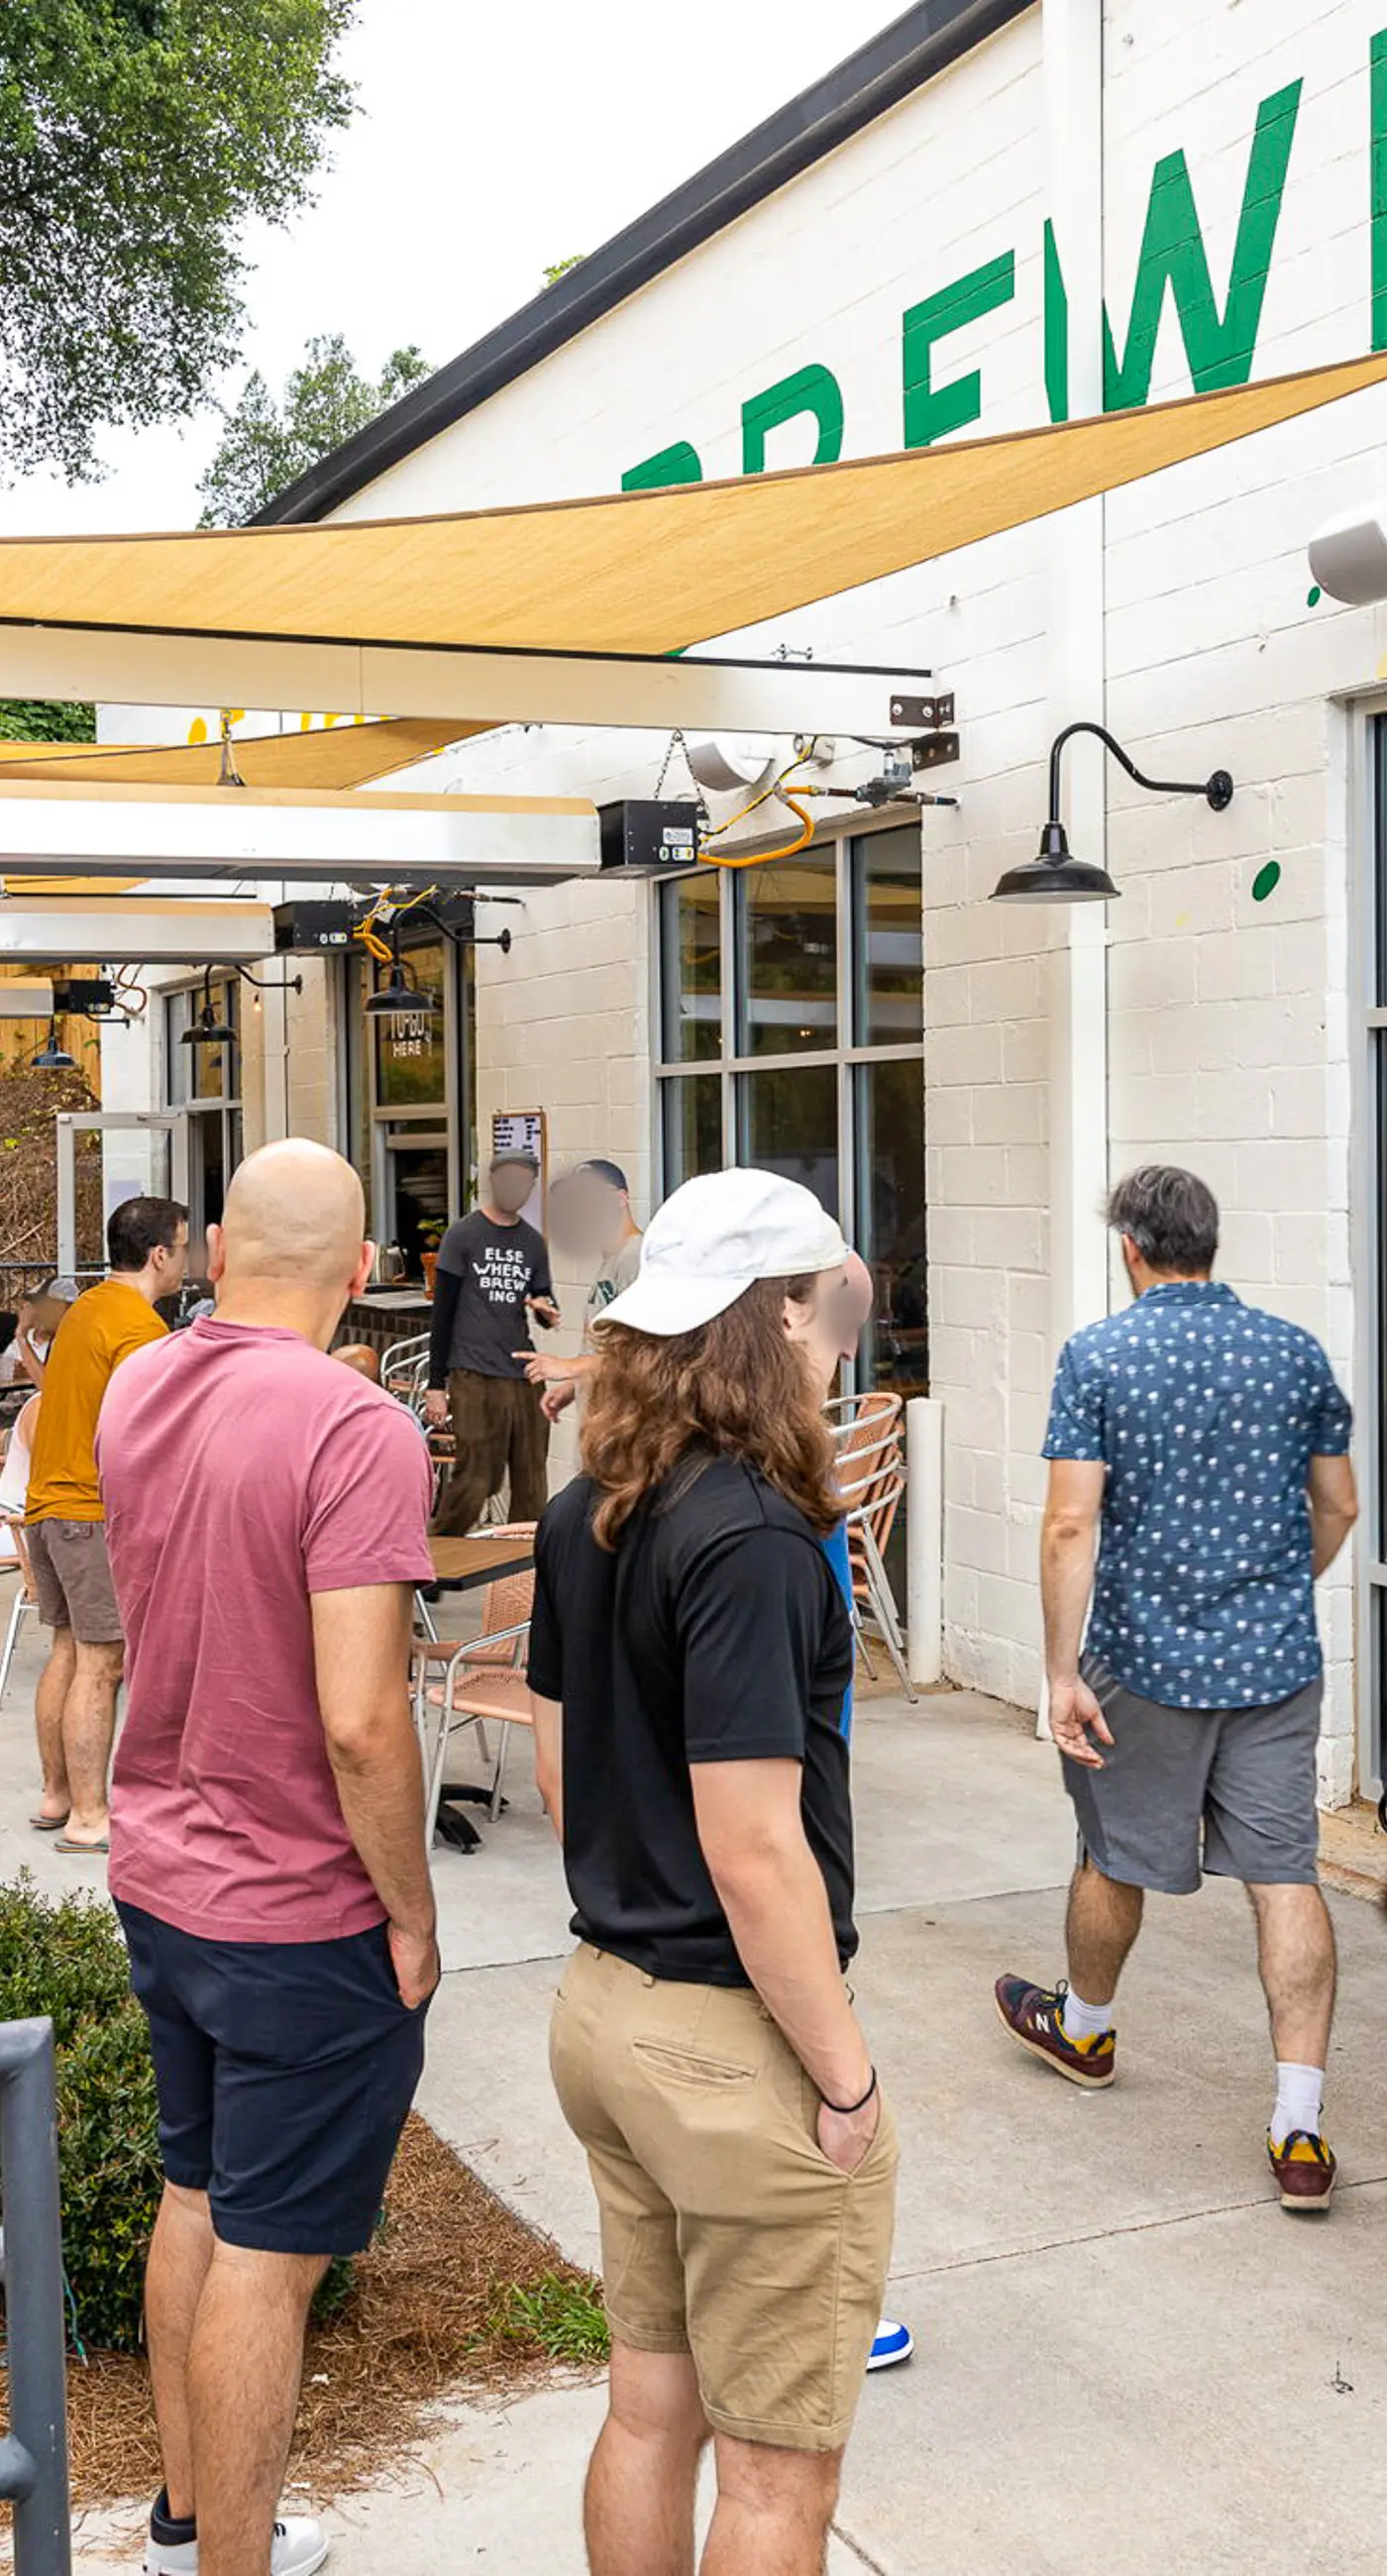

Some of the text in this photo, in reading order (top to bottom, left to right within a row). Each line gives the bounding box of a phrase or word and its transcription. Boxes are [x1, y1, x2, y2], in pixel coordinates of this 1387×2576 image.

[392, 1039, 421, 1057] HERE
[484, 1246, 525, 1264] ELSE
[472, 1261, 532, 1281] WHERE
[480, 1276, 526, 1292] BREW
[488, 1289, 517, 1304] ING
[1035, 2012, 1050, 2033] N
